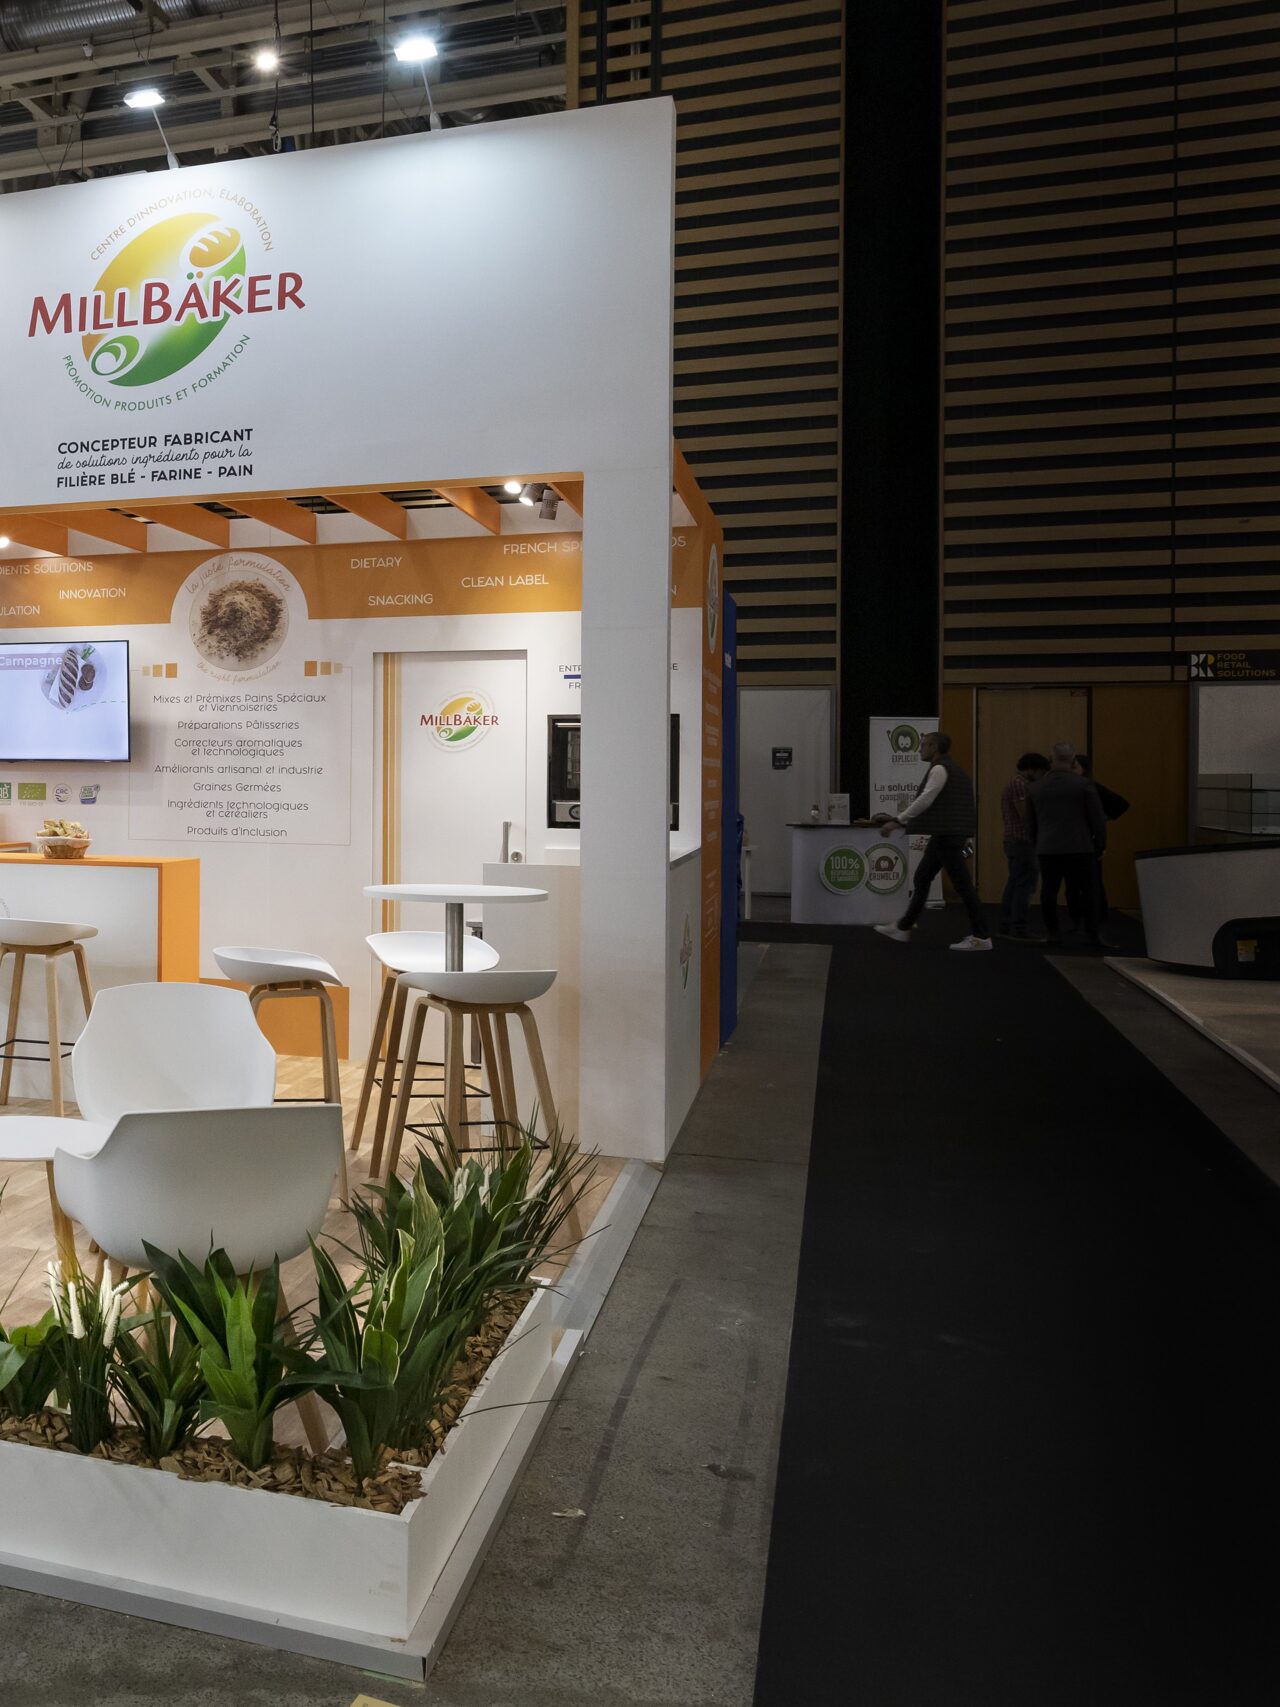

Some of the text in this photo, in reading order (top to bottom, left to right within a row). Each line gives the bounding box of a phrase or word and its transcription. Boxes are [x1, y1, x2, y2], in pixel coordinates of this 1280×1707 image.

[90, 224, 127, 261] CENTRE
[62, 334, 251, 412] PROMOTION PRODUITS ET FORMATION
[57, 428, 253, 455] CONCEPTEUR FABRICANT
[57, 443, 252, 470] de solutions ingrédients pour la
[56, 471, 106, 488] FILIÈRE
[110, 468, 136, 485] BLÉ
[151, 467, 202, 482] FARINE
[218, 464, 254, 478] PAIN
[503, 542, 558, 555] FRENCH
[33, 561, 94, 575] SOLUTIONS
[350, 556, 403, 569] DIETARY
[461, 574, 549, 589] CLEAN LABEL
[59, 587, 127, 600] INNOVATION
[367, 593, 434, 607] SNACKING
[1216, 661, 1251, 669] RETAIL
[1216, 669, 1277, 677] SOLUTIONS
[153, 692, 327, 705] Mixes et Prémixes Pains Spéciaux
[198, 703, 278, 712] et Viennoiseries
[177, 720, 300, 731] Préparations Pâtisseries
[174, 738, 303, 749] Correcteurs aromatiques
[191, 747, 285, 759] et technologiques
[154, 763, 214, 774] Améliorants
[265, 765, 274, 774] et
[278, 765, 323, 775] industrie
[193, 781, 282, 792] Graines Germées
[887, 783, 919, 792] solutio
[167, 798, 309, 812] Ingrédients technologiques
[205, 809, 214, 818] et
[187, 826, 288, 837] Produits d'Inclusion
[831, 855, 860, 870] 100%
